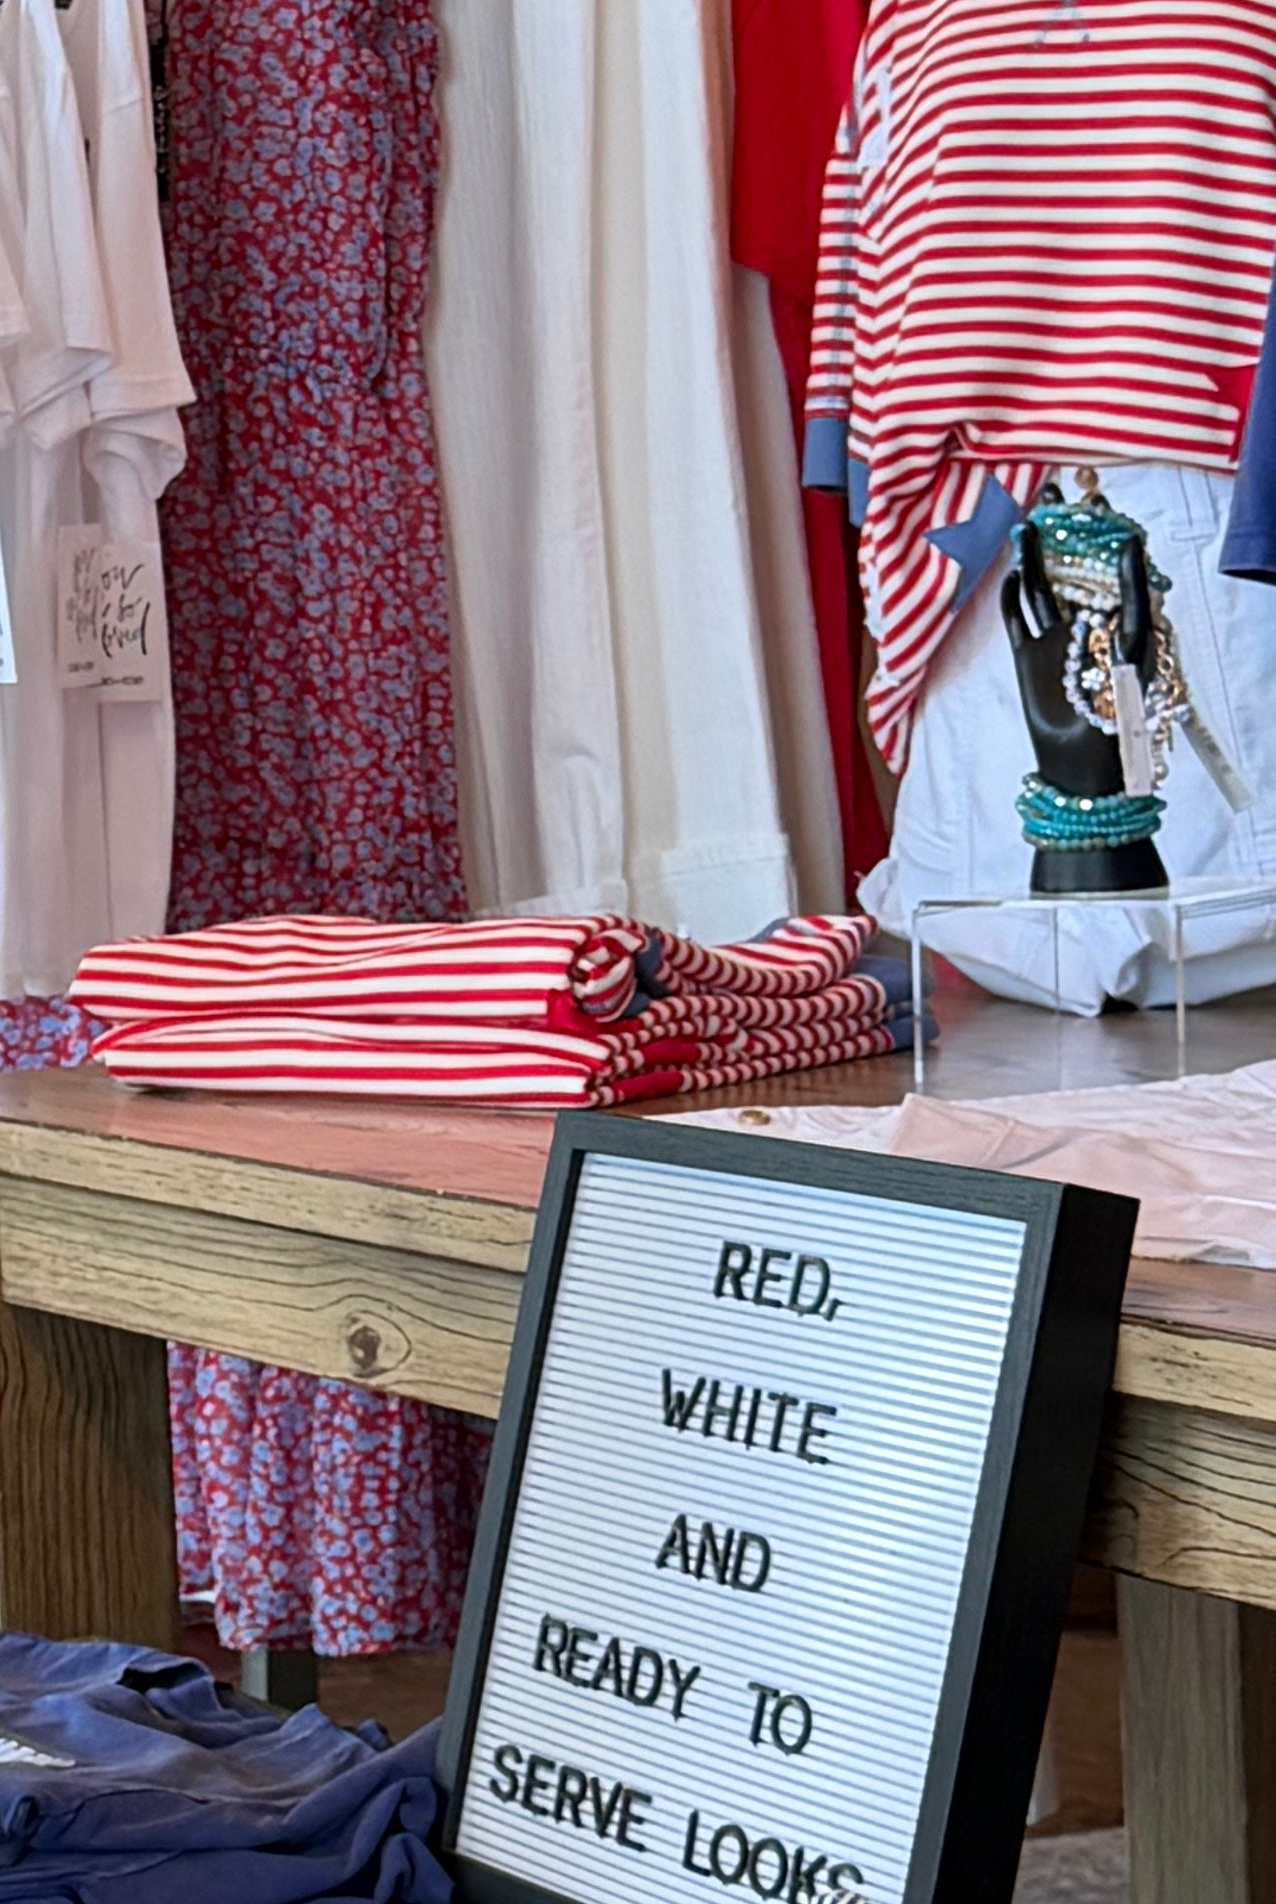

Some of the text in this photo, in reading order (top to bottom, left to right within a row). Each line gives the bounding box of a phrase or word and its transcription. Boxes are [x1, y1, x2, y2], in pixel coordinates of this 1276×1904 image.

[713, 1240, 843, 1322] RED,
[661, 1367, 837, 1465] WHITE
[655, 1513, 771, 1593] AND
[533, 1612, 812, 1755] READY TO
[489, 1742, 653, 1852] SERVE
